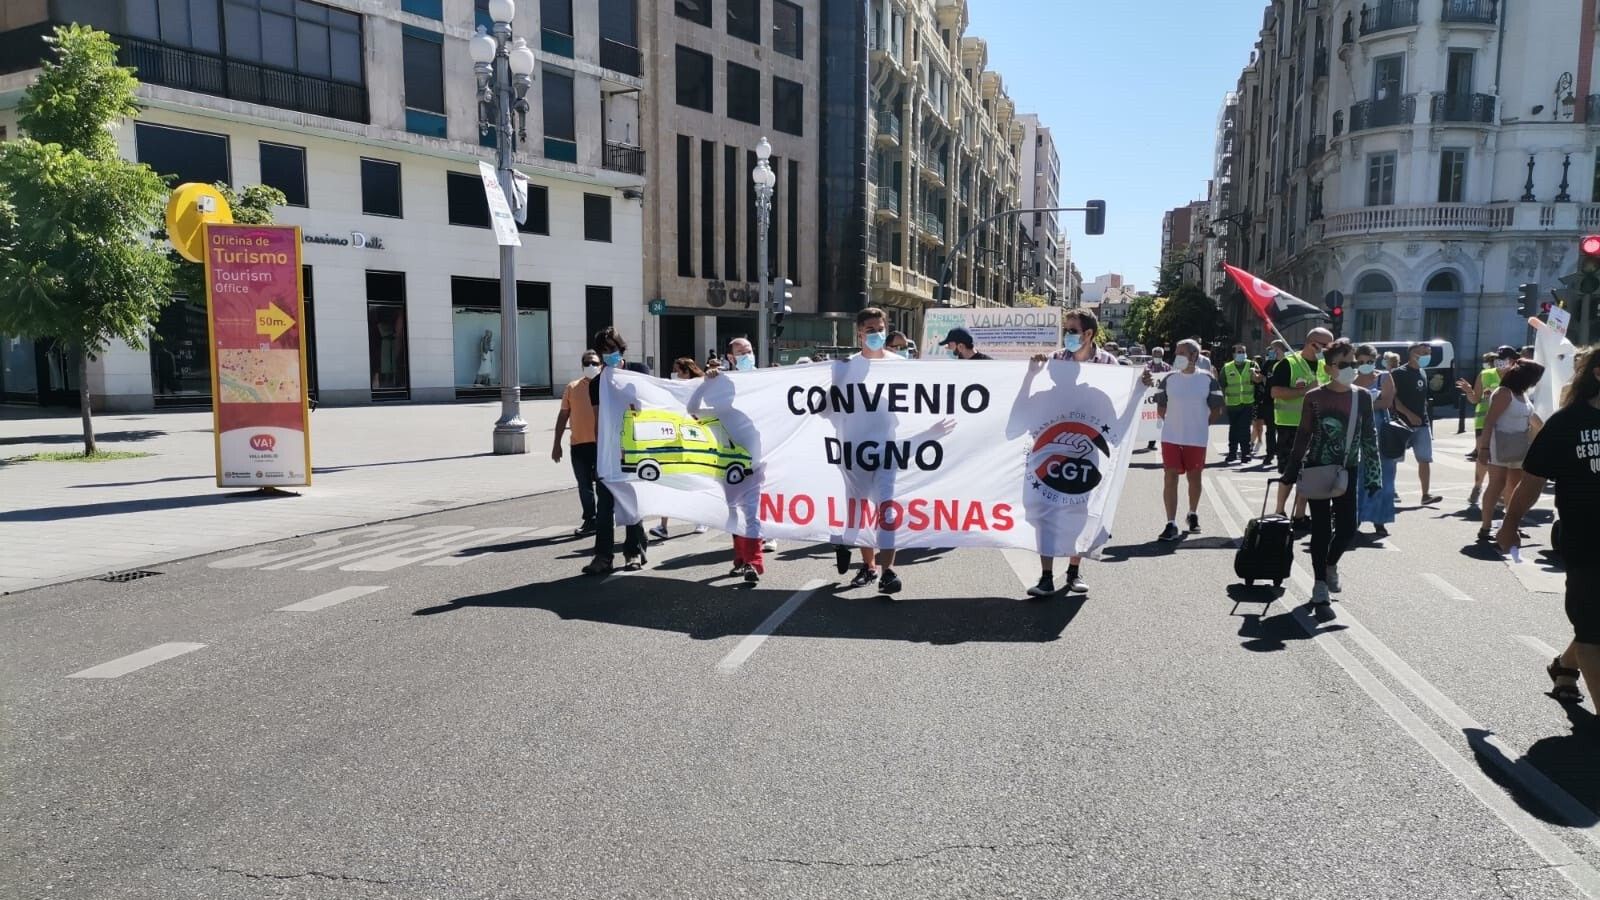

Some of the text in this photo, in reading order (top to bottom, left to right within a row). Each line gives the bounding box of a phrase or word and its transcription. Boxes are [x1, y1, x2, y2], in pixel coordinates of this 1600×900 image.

[213, 235, 270, 246] Oficina de
[300, 227, 348, 246] assimo
[213, 248, 288, 264] Turismo
[215, 269, 272, 281] Tourism
[215, 283, 249, 293] Office
[787, 383, 990, 415] CONVENIO
[1141, 411, 1159, 420] PRE
[661, 427, 674, 435] 112
[1580, 430, 1590, 442] LE
[252, 438, 273, 448] VA!
[824, 437, 943, 471] DIGNO
[1576, 442, 1600, 459] CE SO
[1046, 461, 1093, 483] CGT
[760, 493, 1015, 532] NO LIMOSNAS
